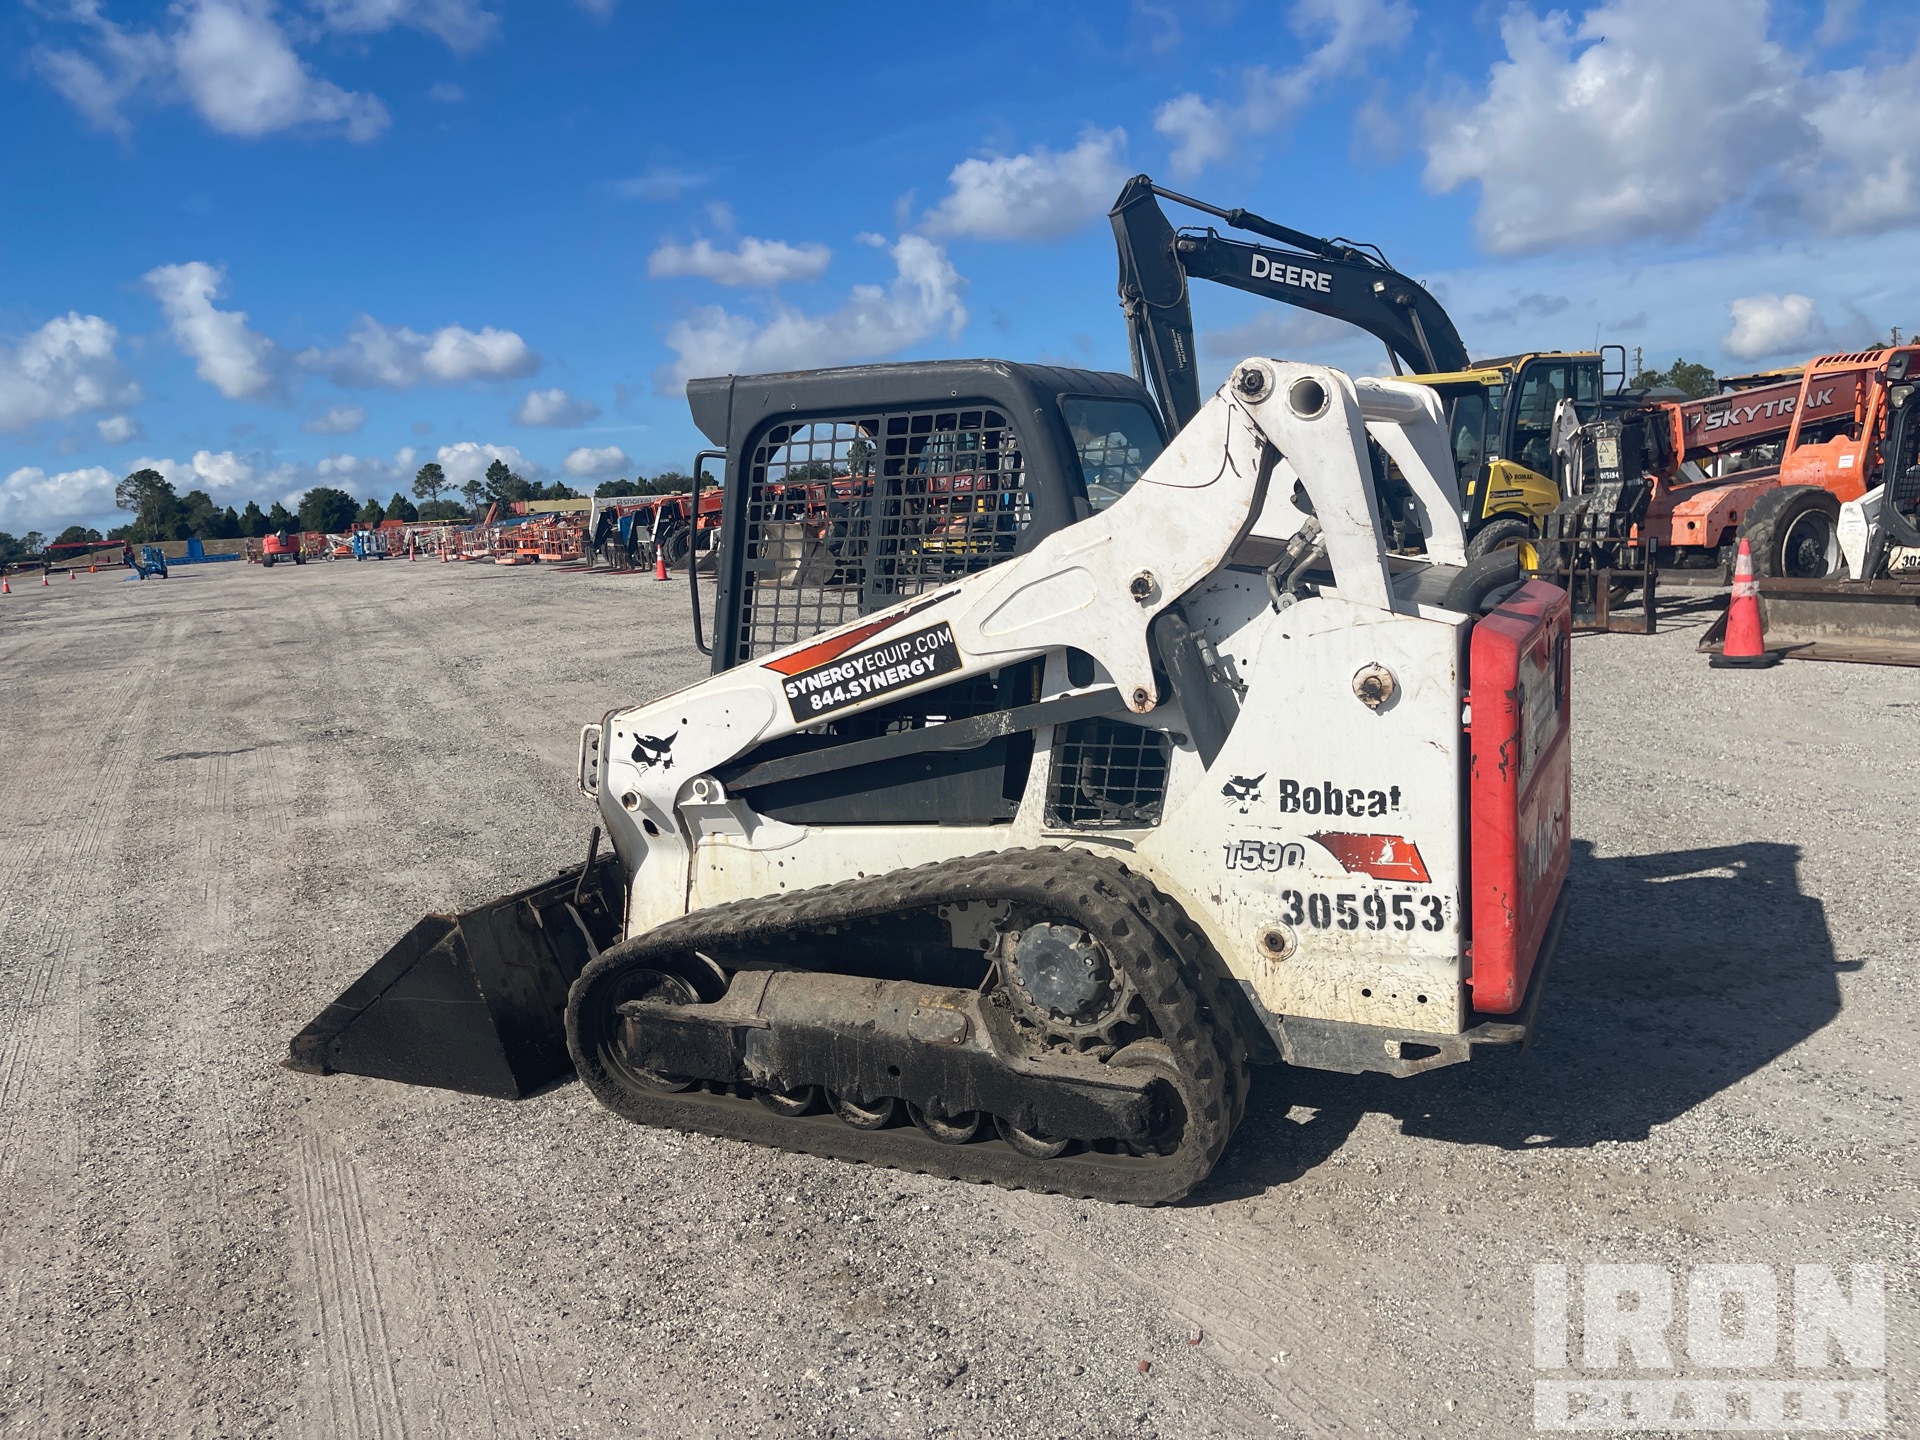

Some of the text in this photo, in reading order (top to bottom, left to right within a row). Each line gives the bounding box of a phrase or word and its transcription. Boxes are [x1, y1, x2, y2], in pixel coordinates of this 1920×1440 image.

[1251, 254, 1332, 293] DEERE
[1704, 386, 1836, 432] SKYTRAK
[785, 627, 954, 699] SYNERGYEQUIP.COM
[810, 654, 936, 710] 844.SYNERGY
[1279, 779, 1402, 818] Bobcat
[1223, 839, 1306, 873] T590
[1281, 889, 1445, 932] 305953
